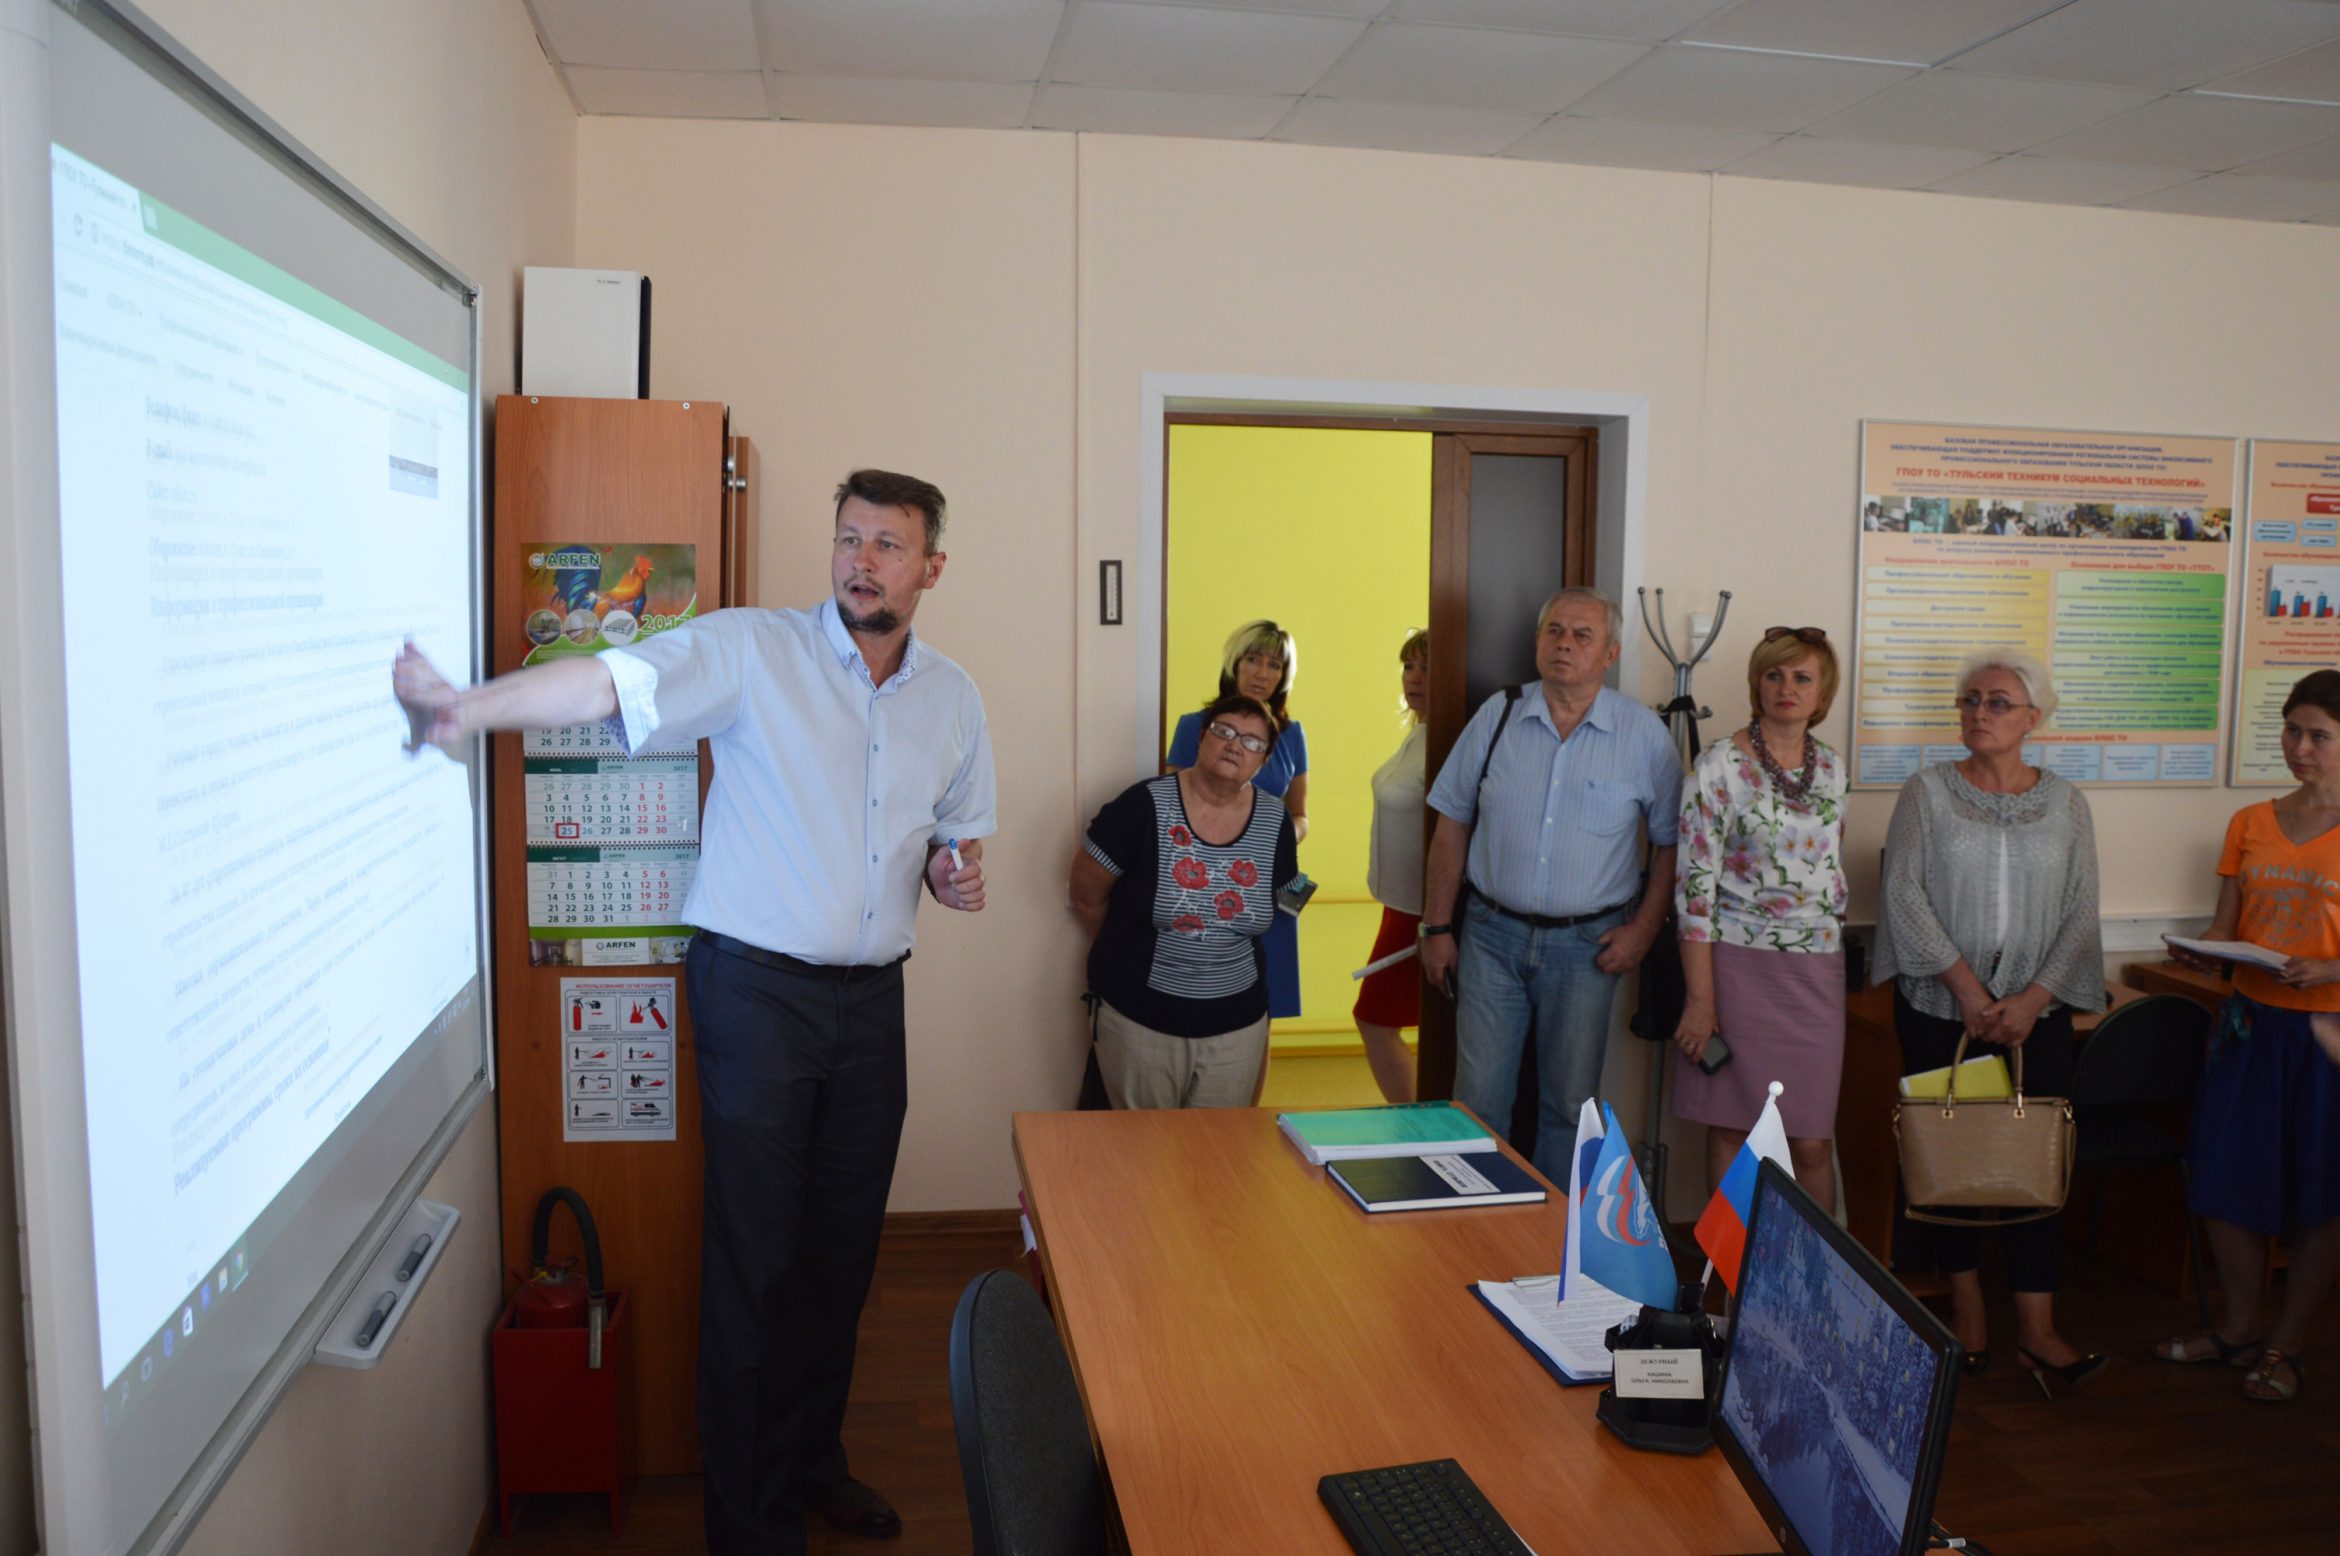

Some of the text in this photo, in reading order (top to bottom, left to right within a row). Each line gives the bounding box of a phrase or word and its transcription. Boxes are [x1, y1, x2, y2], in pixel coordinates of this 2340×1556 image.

[1896, 467, 2206, 488] ГПОУ ТО «ТУЛЬСКИЙ ТЕХНИКУМ СОЦИАЛЬНЫХ ТЕХНОЛОГИЙ»
[547, 553, 600, 565] ARFEN
[541, 738, 610, 746] 26 27 28 29
[561, 782, 571, 790] 27
[640, 782, 644, 790] 1
[658, 782, 663, 790] 2
[622, 793, 627, 801] 7
[639, 793, 645, 801] 8
[637, 804, 648, 812] 15
[656, 815, 666, 823] 23
[561, 827, 573, 835] 25
[582, 827, 593, 835] 26
[601, 827, 612, 835] 27
[637, 826, 648, 834] 29
[656, 826, 667, 834] 30
[605, 871, 609, 879] 3
[660, 870, 666, 878] 6
[641, 881, 651, 889] 12
[566, 904, 576, 912] 22
[584, 904, 594, 912] 23
[658, 903, 669, 911] 27
[548, 915, 559, 923] 28
[566, 915, 576, 923] 29
[584, 915, 594, 923] 30
[606, 941, 636, 949] ARFEN
[1640, 1357, 1679, 1365] ДЕЖУРНЫЙ
